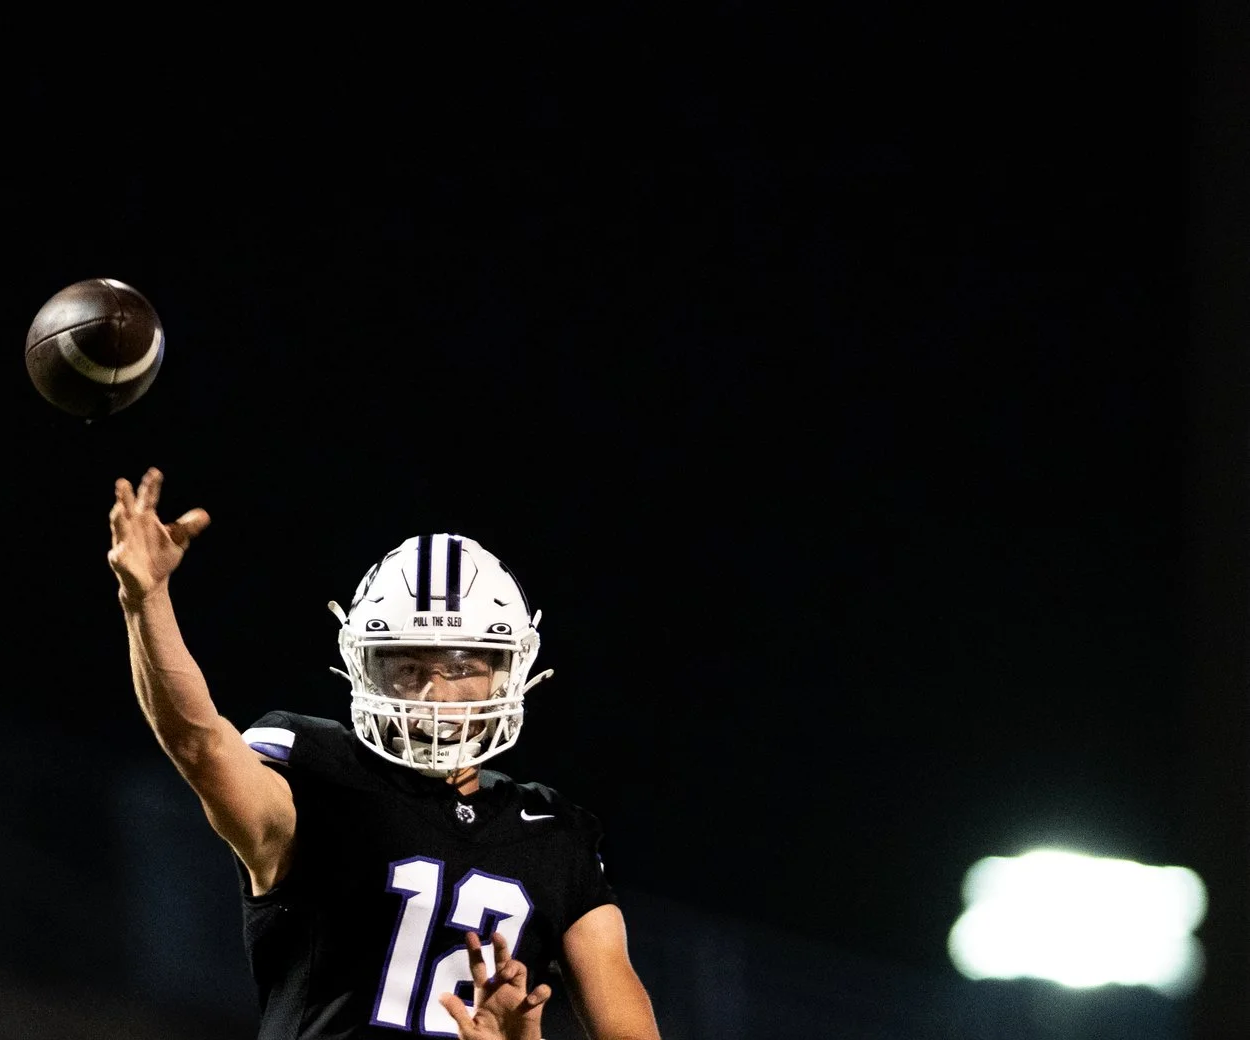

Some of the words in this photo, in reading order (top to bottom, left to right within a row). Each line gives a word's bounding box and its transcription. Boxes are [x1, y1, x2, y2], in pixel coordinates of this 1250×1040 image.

[413, 616, 428, 627] PULL
[432, 616, 444, 627] THE
[447, 616, 462, 628] SLED
[369, 855, 534, 1037] 12
